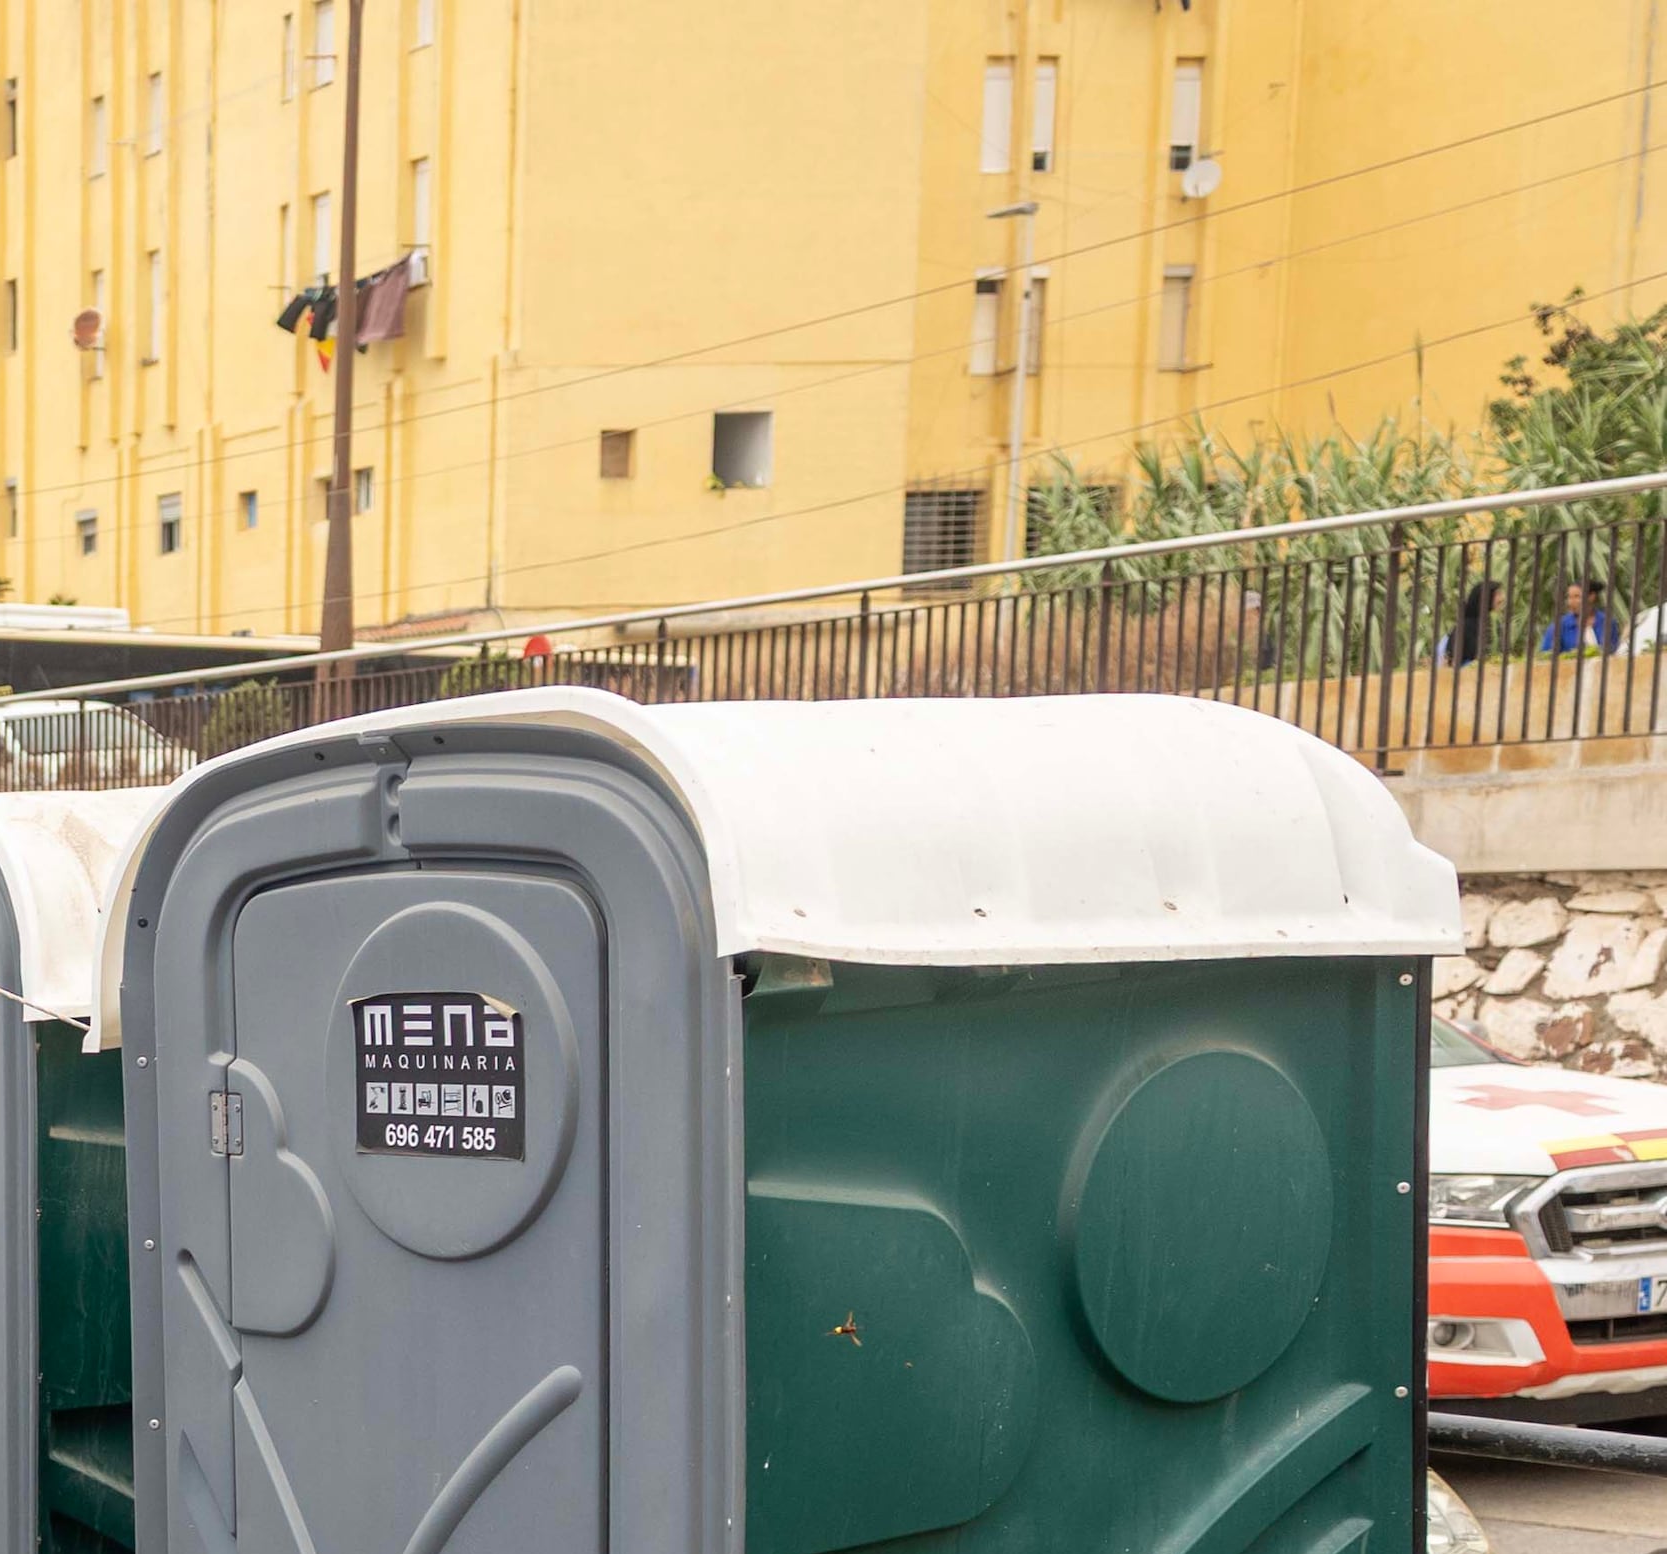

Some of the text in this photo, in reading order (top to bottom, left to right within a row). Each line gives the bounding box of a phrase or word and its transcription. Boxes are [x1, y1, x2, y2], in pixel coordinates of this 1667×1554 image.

[365, 1053, 516, 1071] MAQUINARIA
[385, 1123, 496, 1151] 696 471 585
